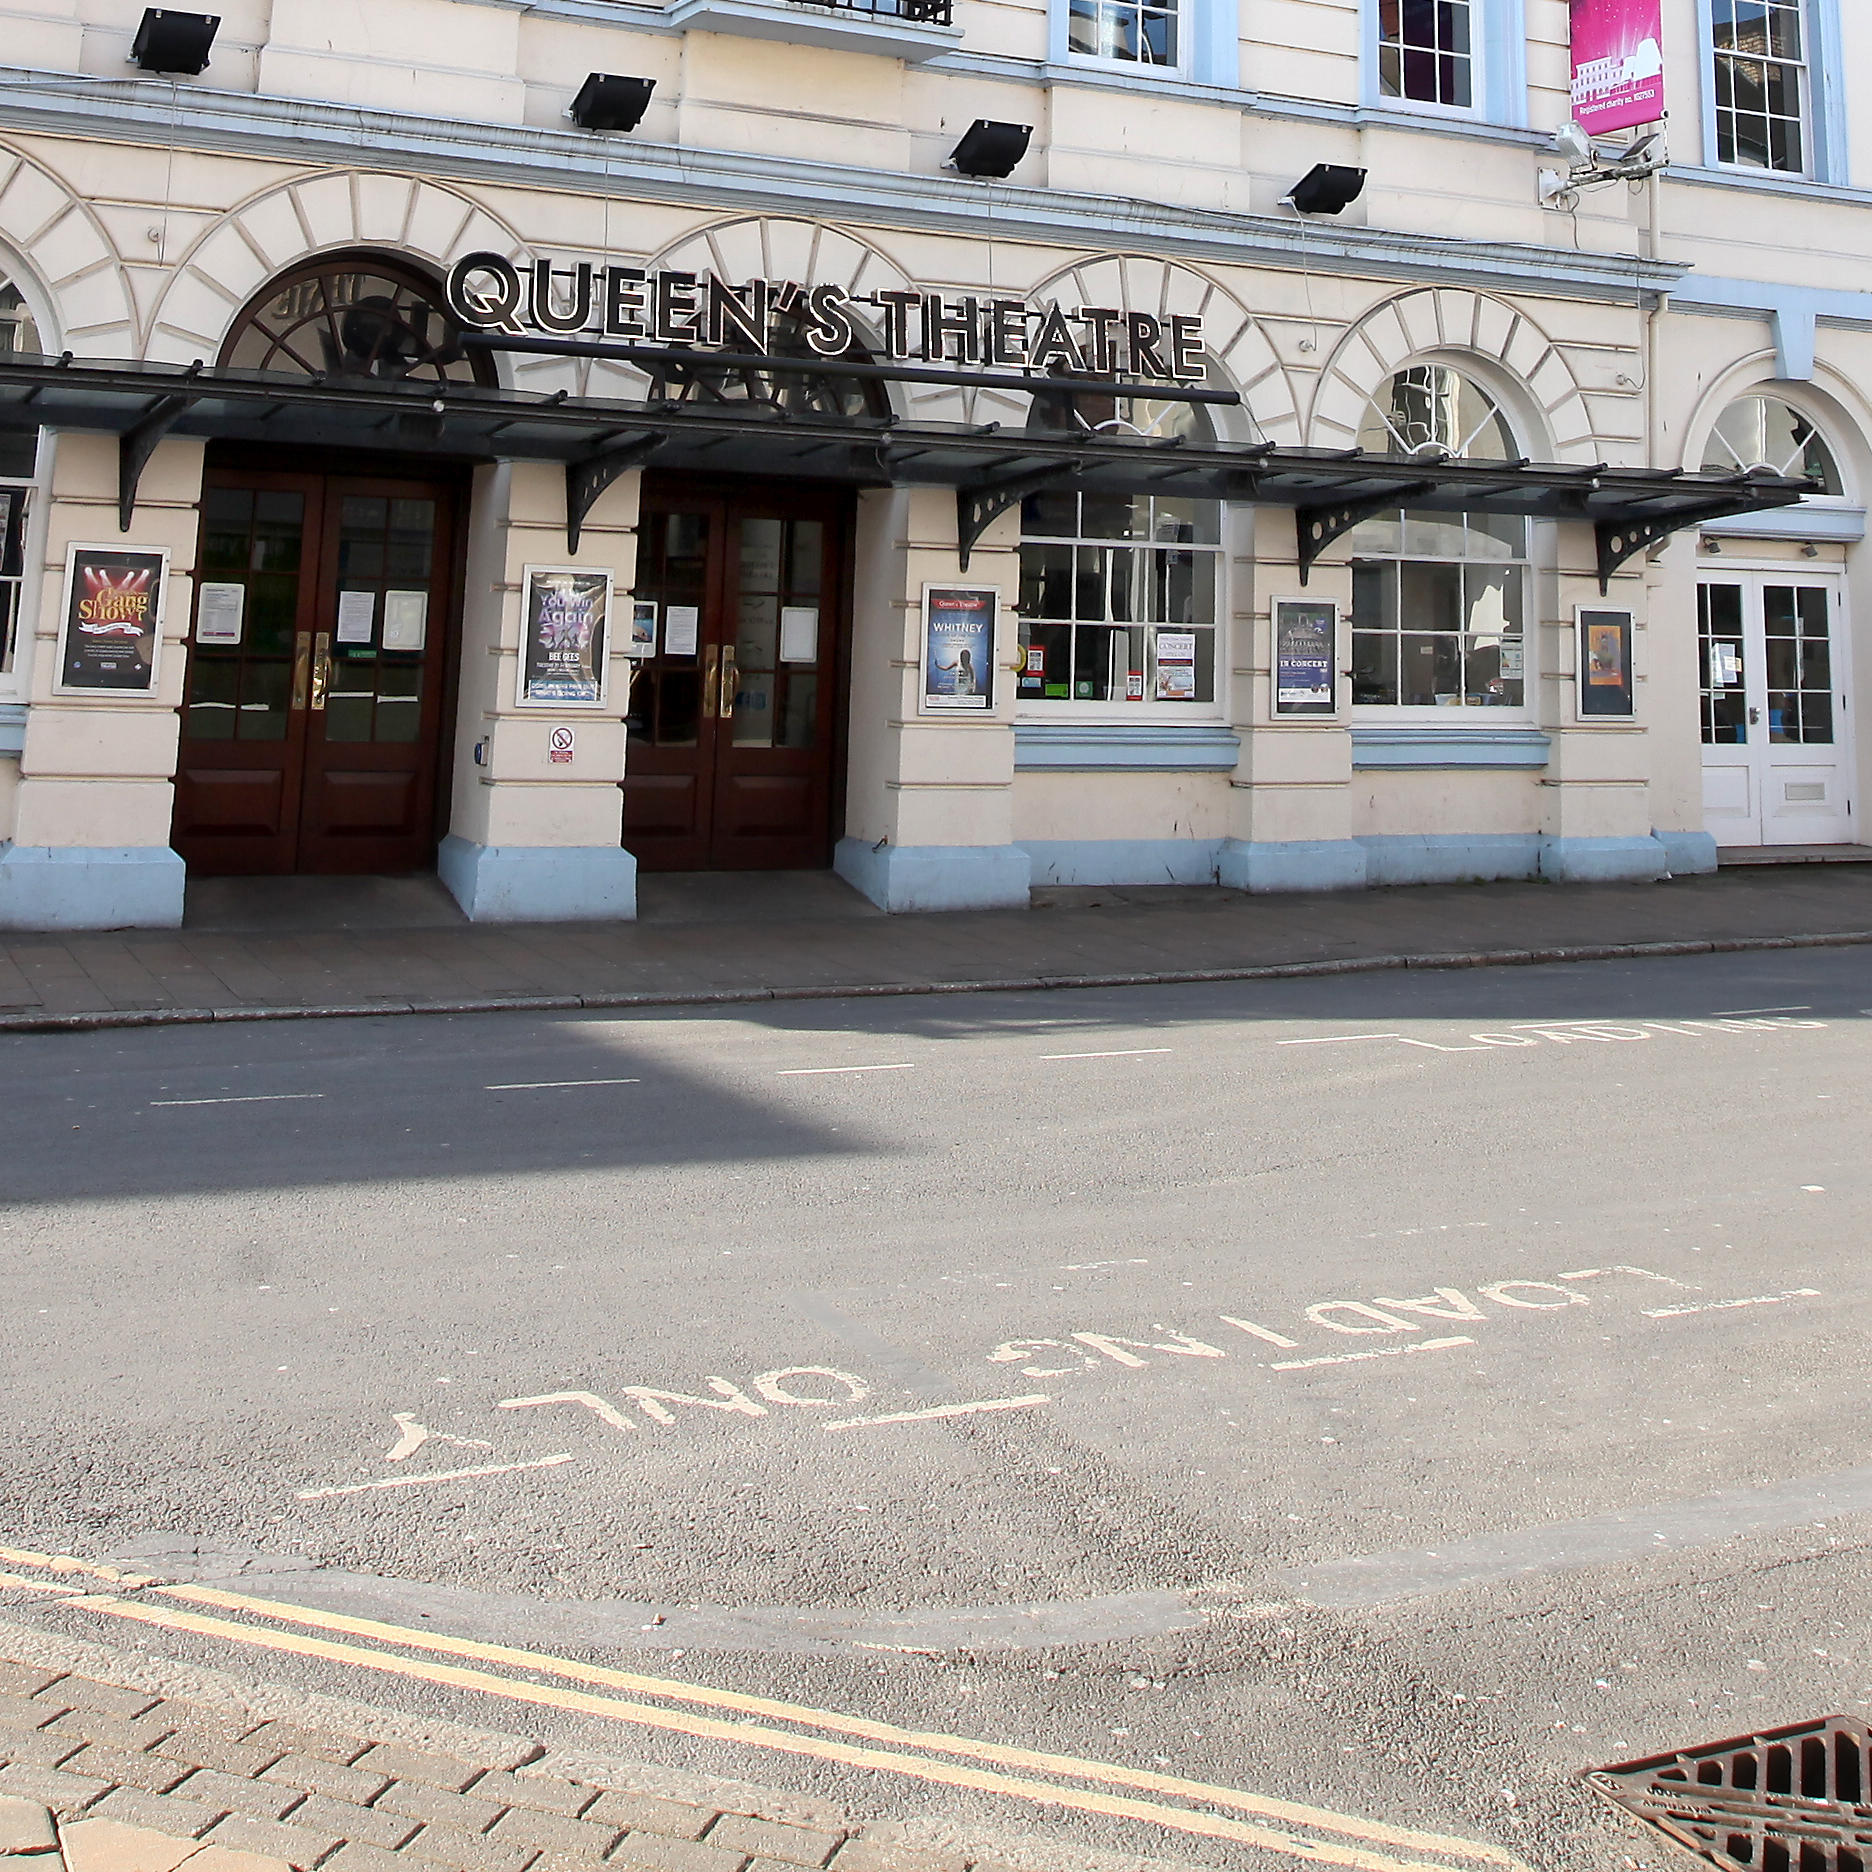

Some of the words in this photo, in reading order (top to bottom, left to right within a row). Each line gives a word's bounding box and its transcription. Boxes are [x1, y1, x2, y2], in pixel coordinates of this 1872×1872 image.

[446, 250, 852, 356] QUEEN'S
[875, 288, 1207, 380] THEATRE
[96, 587, 148, 613] Gang
[540, 589, 566, 607] You
[568, 592, 593, 608] Win
[538, 608, 593, 626] Again
[933, 623, 983, 632] WHITNEY
[1398, 1017, 1828, 1052] LOADING
[985, 1264, 1704, 1379] LOADING
[384, 1365, 874, 1463] ONLY
